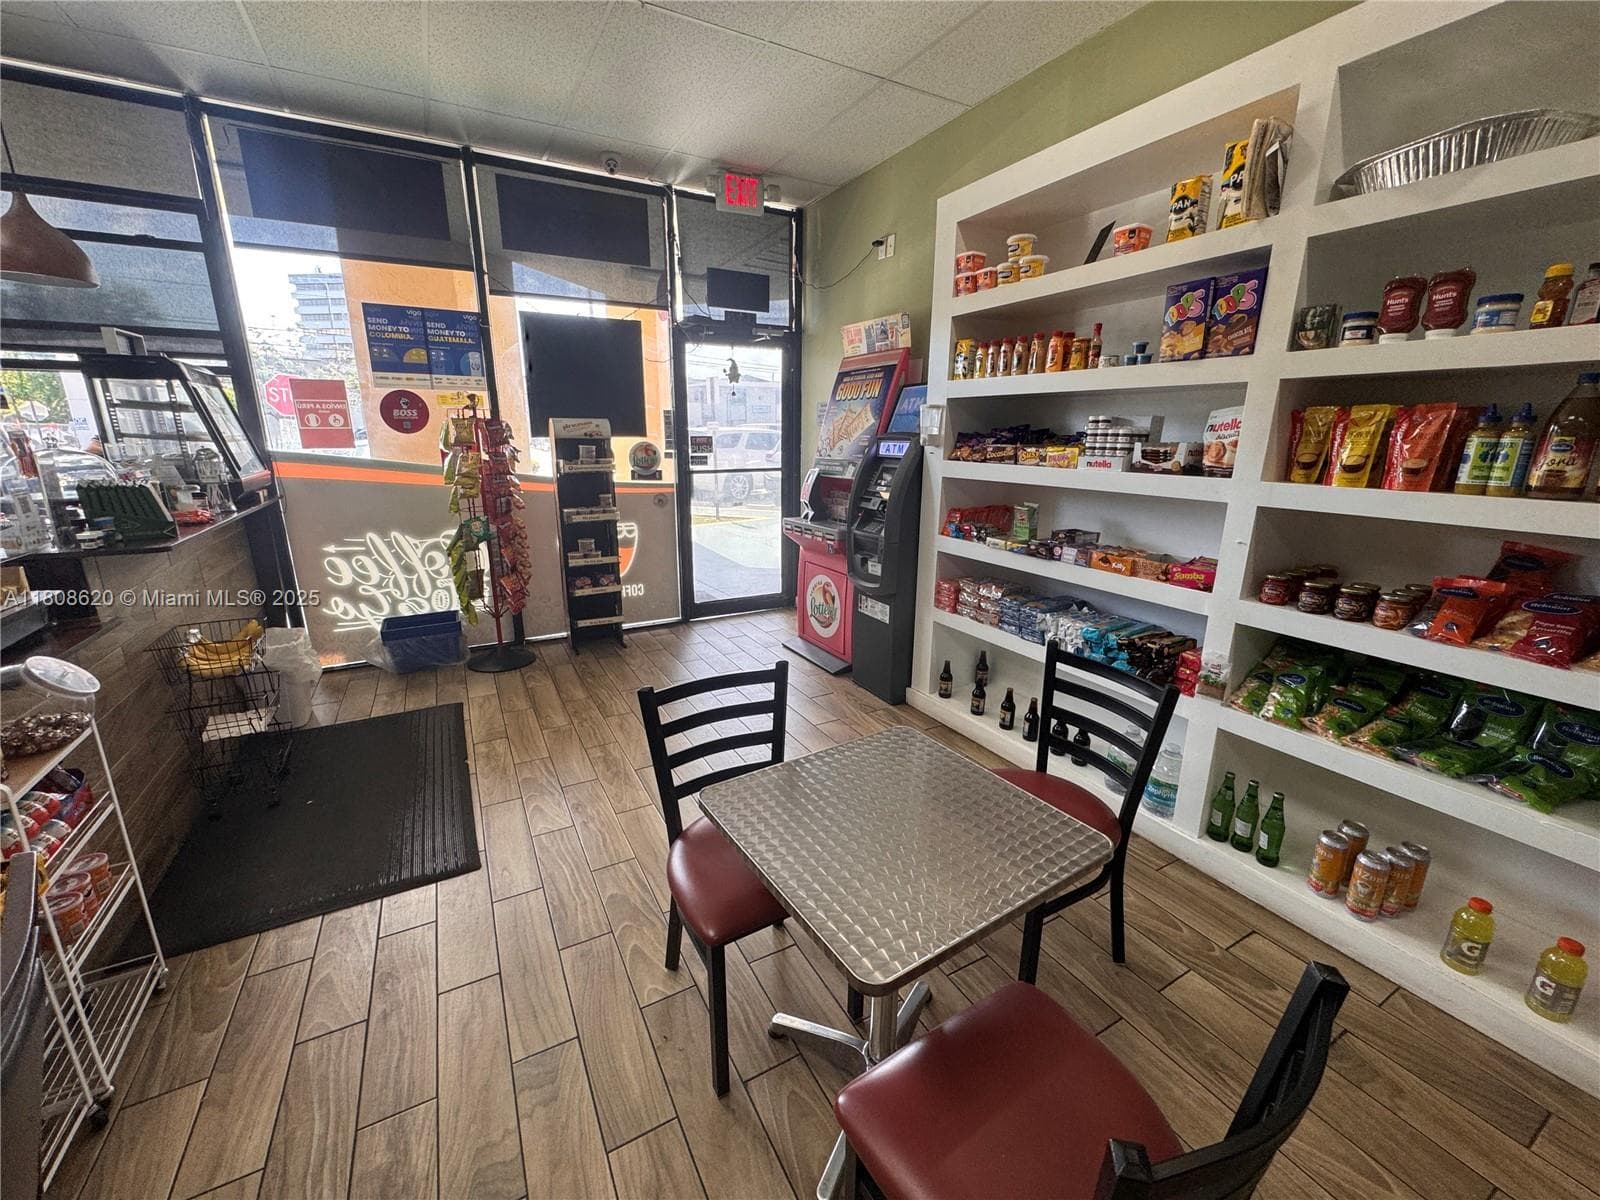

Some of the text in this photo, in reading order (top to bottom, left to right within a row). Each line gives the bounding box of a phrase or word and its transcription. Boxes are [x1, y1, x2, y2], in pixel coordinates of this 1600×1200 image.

[725, 171, 759, 209] EXIT
[1172, 199, 1191, 211] PAN
[406, 309, 422, 318] vigo
[463, 314, 478, 322] vigo
[367, 317, 388, 325] SEND
[368, 324, 398, 332] MONEY
[426, 322, 446, 330] SEND
[427, 329, 455, 337] MONEY
[836, 379, 884, 401] GOOD FUN
[269, 387, 293, 403] ST
[393, 409, 418, 417] BOSS
[885, 443, 905, 455] ATM
[1086, 460, 1112, 468] nutella
[1173, 572, 1206, 581] Samba
[1461, 941, 1482, 957] G
[1535, 975, 1556, 997] G
